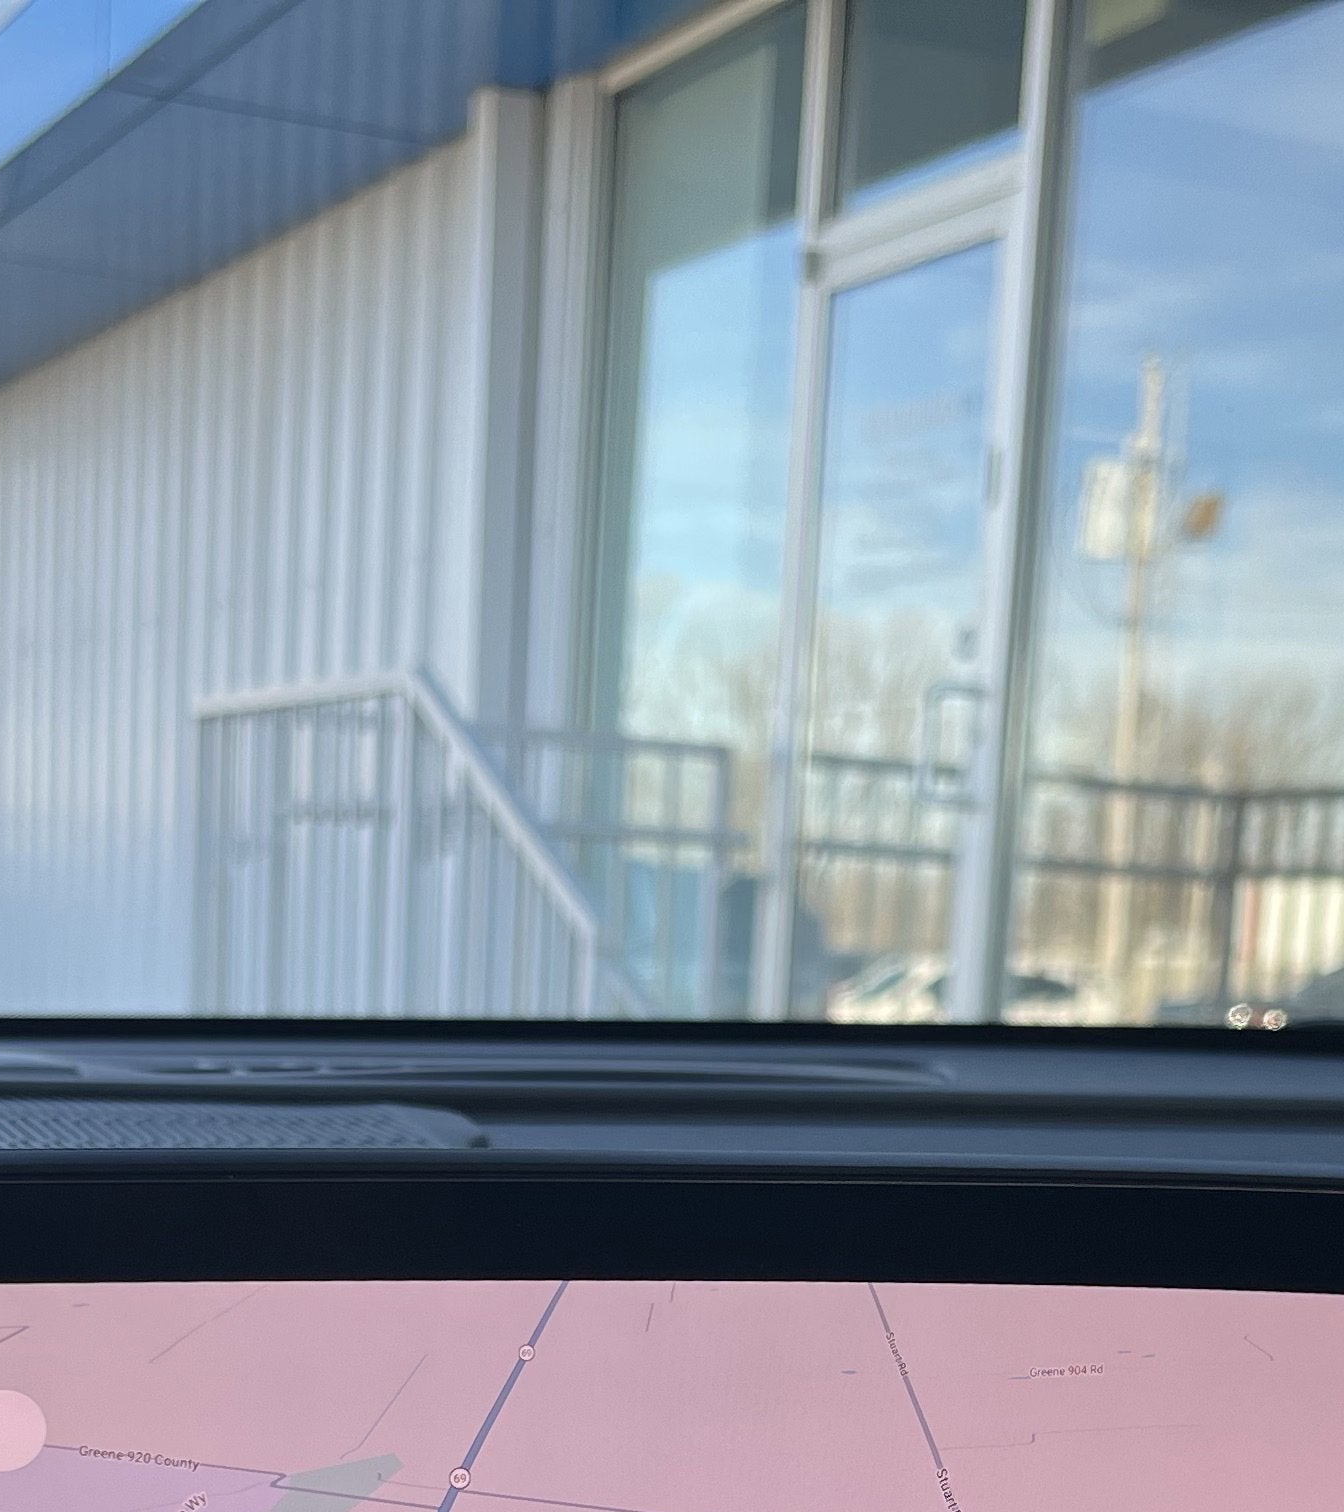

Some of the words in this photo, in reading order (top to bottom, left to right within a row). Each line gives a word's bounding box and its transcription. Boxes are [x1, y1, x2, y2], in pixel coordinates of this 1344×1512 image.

[886, 1332, 902, 1364] Stuart
[897, 1361, 909, 1377] Rd
[1029, 1367, 1065, 1378] Greene
[1068, 1366, 1087, 1376] 904
[1090, 1364, 1104, 1375] Rd
[79, 1445, 125, 1461] Greene
[127, 1450, 152, 1464] 920
[154, 1454, 200, 1472] County
[185, 1494, 207, 1511] Wy
[936, 1468, 957, 1511] Stuart
